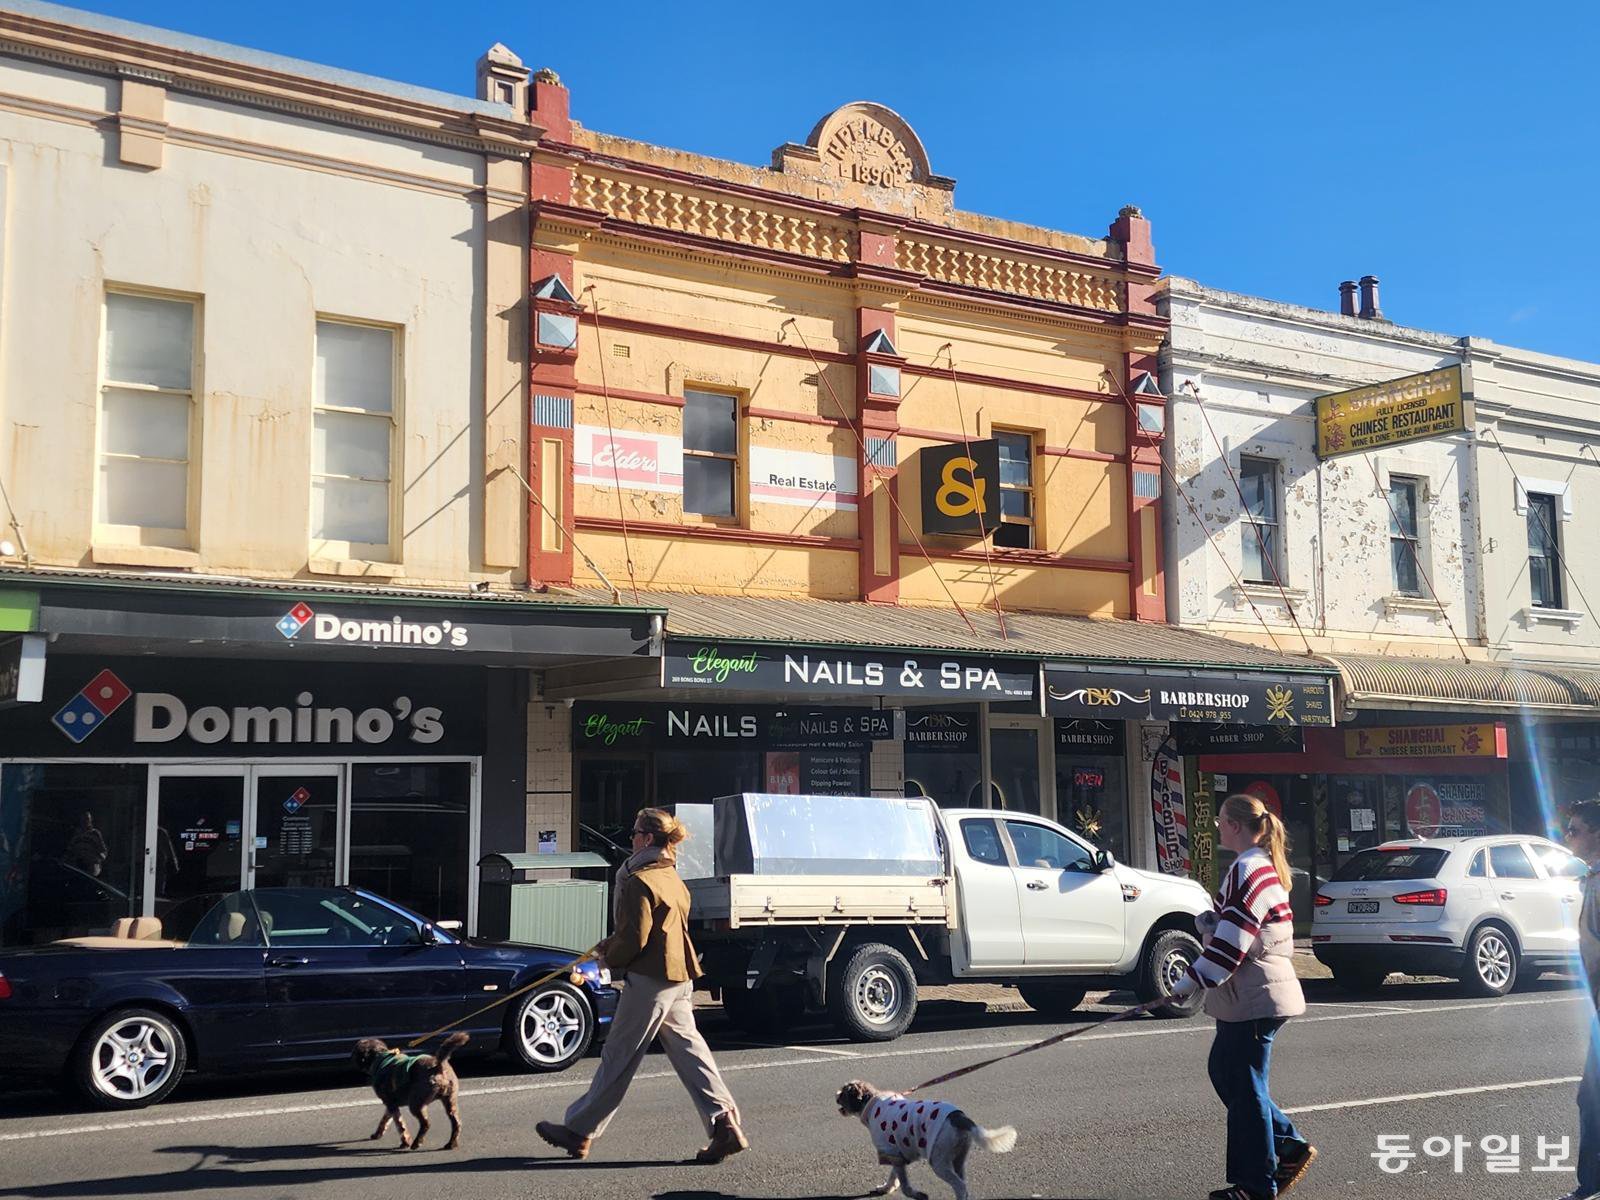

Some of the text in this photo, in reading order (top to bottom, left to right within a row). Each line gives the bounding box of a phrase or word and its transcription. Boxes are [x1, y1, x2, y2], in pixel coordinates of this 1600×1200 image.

[851, 163, 894, 188] 1890
[1350, 371, 1451, 412] SHANGHAI
[1350, 402, 1456, 438] CHINESE RESTAURANT
[1376, 398, 1428, 417] FULLY LICENSED
[1351, 437, 1369, 448] WINE
[1375, 433, 1391, 443] DINE
[1396, 430, 1412, 438] TAKE
[1413, 425, 1431, 436] AWAY
[1433, 419, 1456, 431] MEALS
[593, 443, 658, 472] Elders
[769, 473, 837, 492] Real Estate
[314, 613, 469, 647] Domino's
[687, 647, 771, 683] Elegant
[900, 660, 925, 688] &
[133, 691, 445, 745] Domino's
[843, 717, 854, 733] &
[1188, 711, 1232, 720] 0424 978 955
[579, 714, 655, 746] Elegant
[1388, 727, 1445, 744] SHANGHAI
[1379, 744, 1457, 756] CHINESE RESTAURANT
[1074, 772, 1103, 787] OPEN
[1160, 760, 1179, 860] BARBER
[1165, 858, 1184, 872] SHOP
